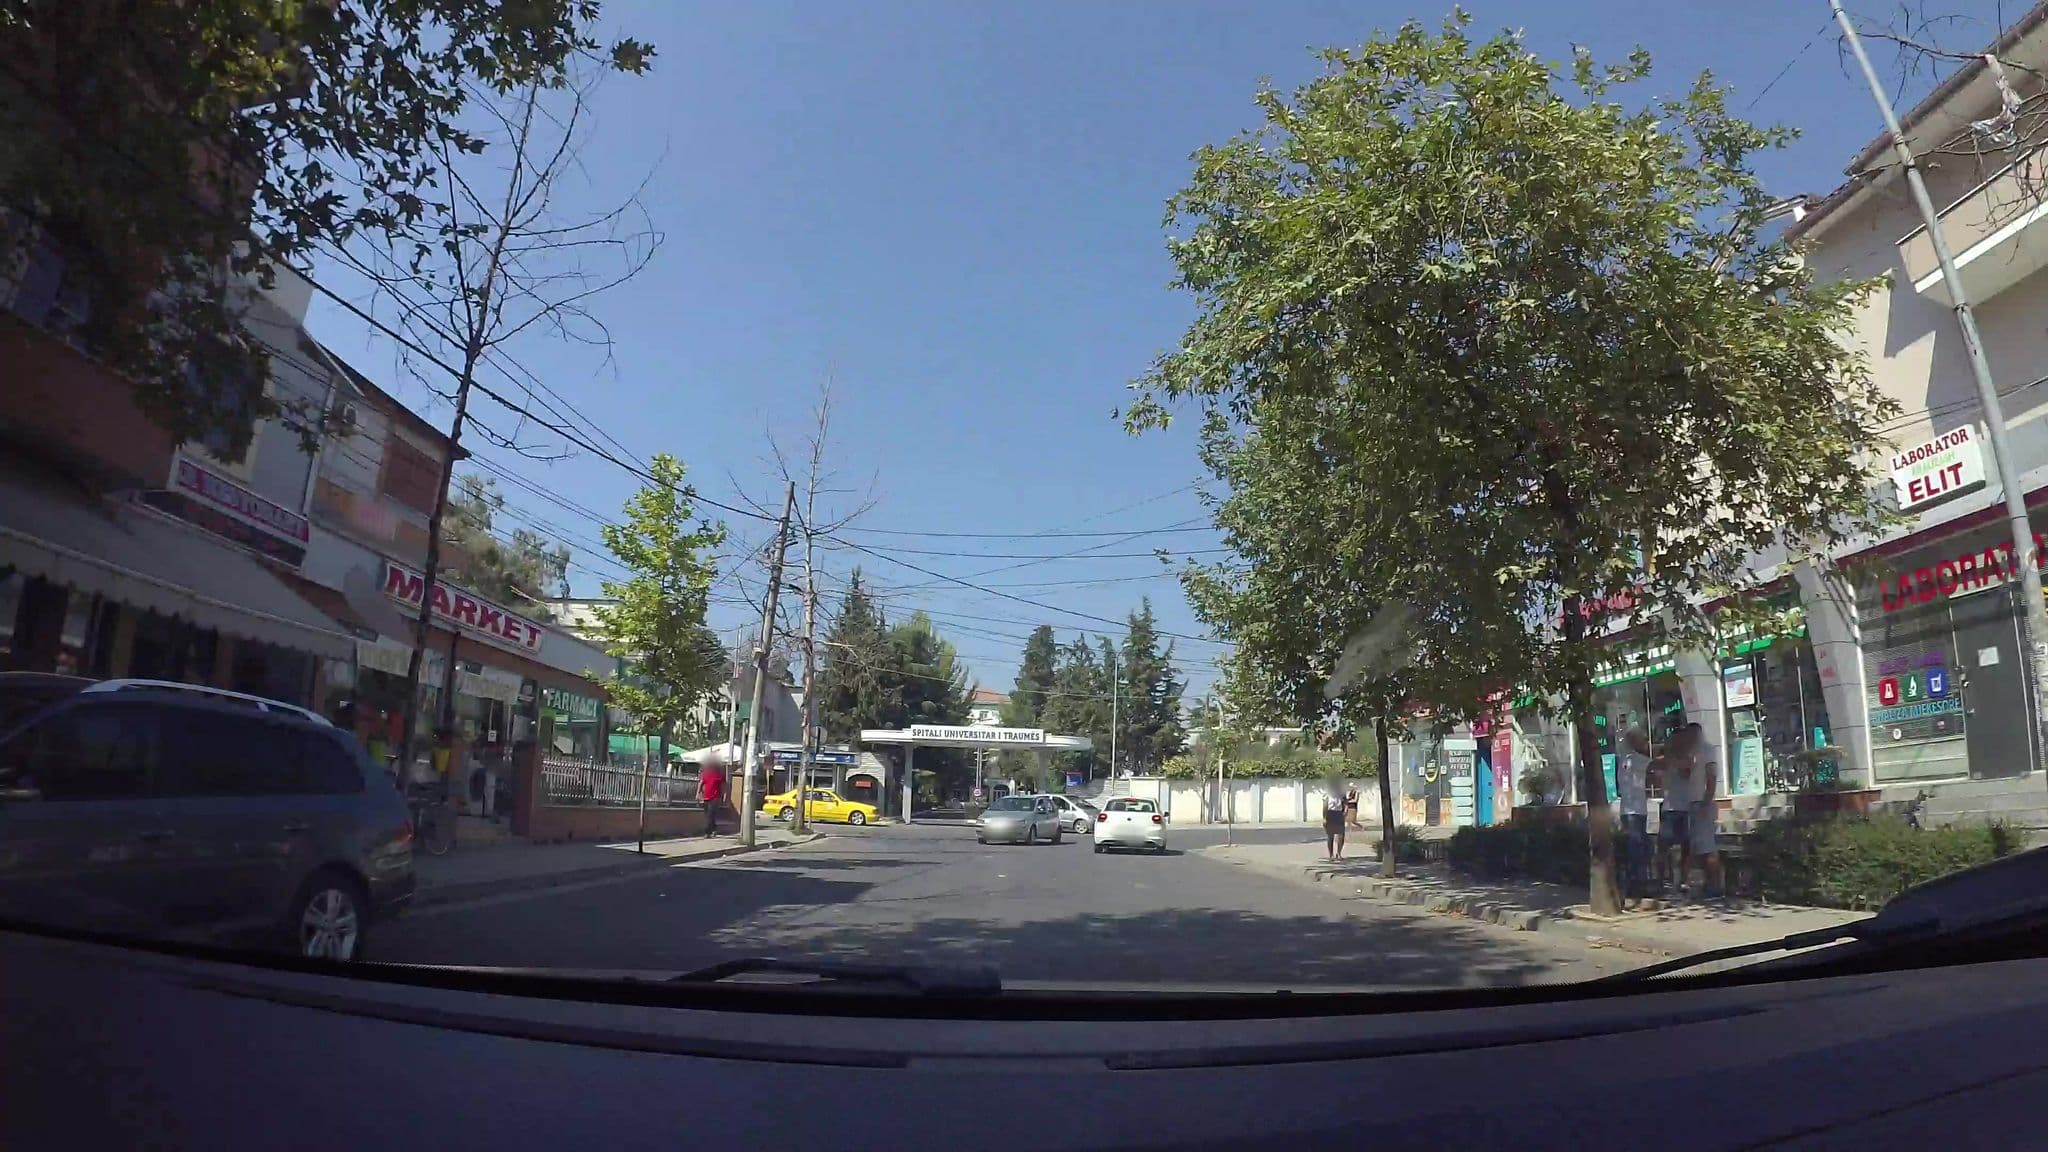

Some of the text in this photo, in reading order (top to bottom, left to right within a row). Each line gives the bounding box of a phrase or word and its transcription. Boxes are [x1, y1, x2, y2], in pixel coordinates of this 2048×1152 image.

[1892, 428, 1969, 471] LABORATOR
[1908, 461, 1963, 503] ELIT
[385, 564, 543, 648] MARKET
[546, 687, 597, 718] FARMACI
[912, 728, 942, 737] SPITALI
[944, 729, 996, 740] UNIVERSITAR
